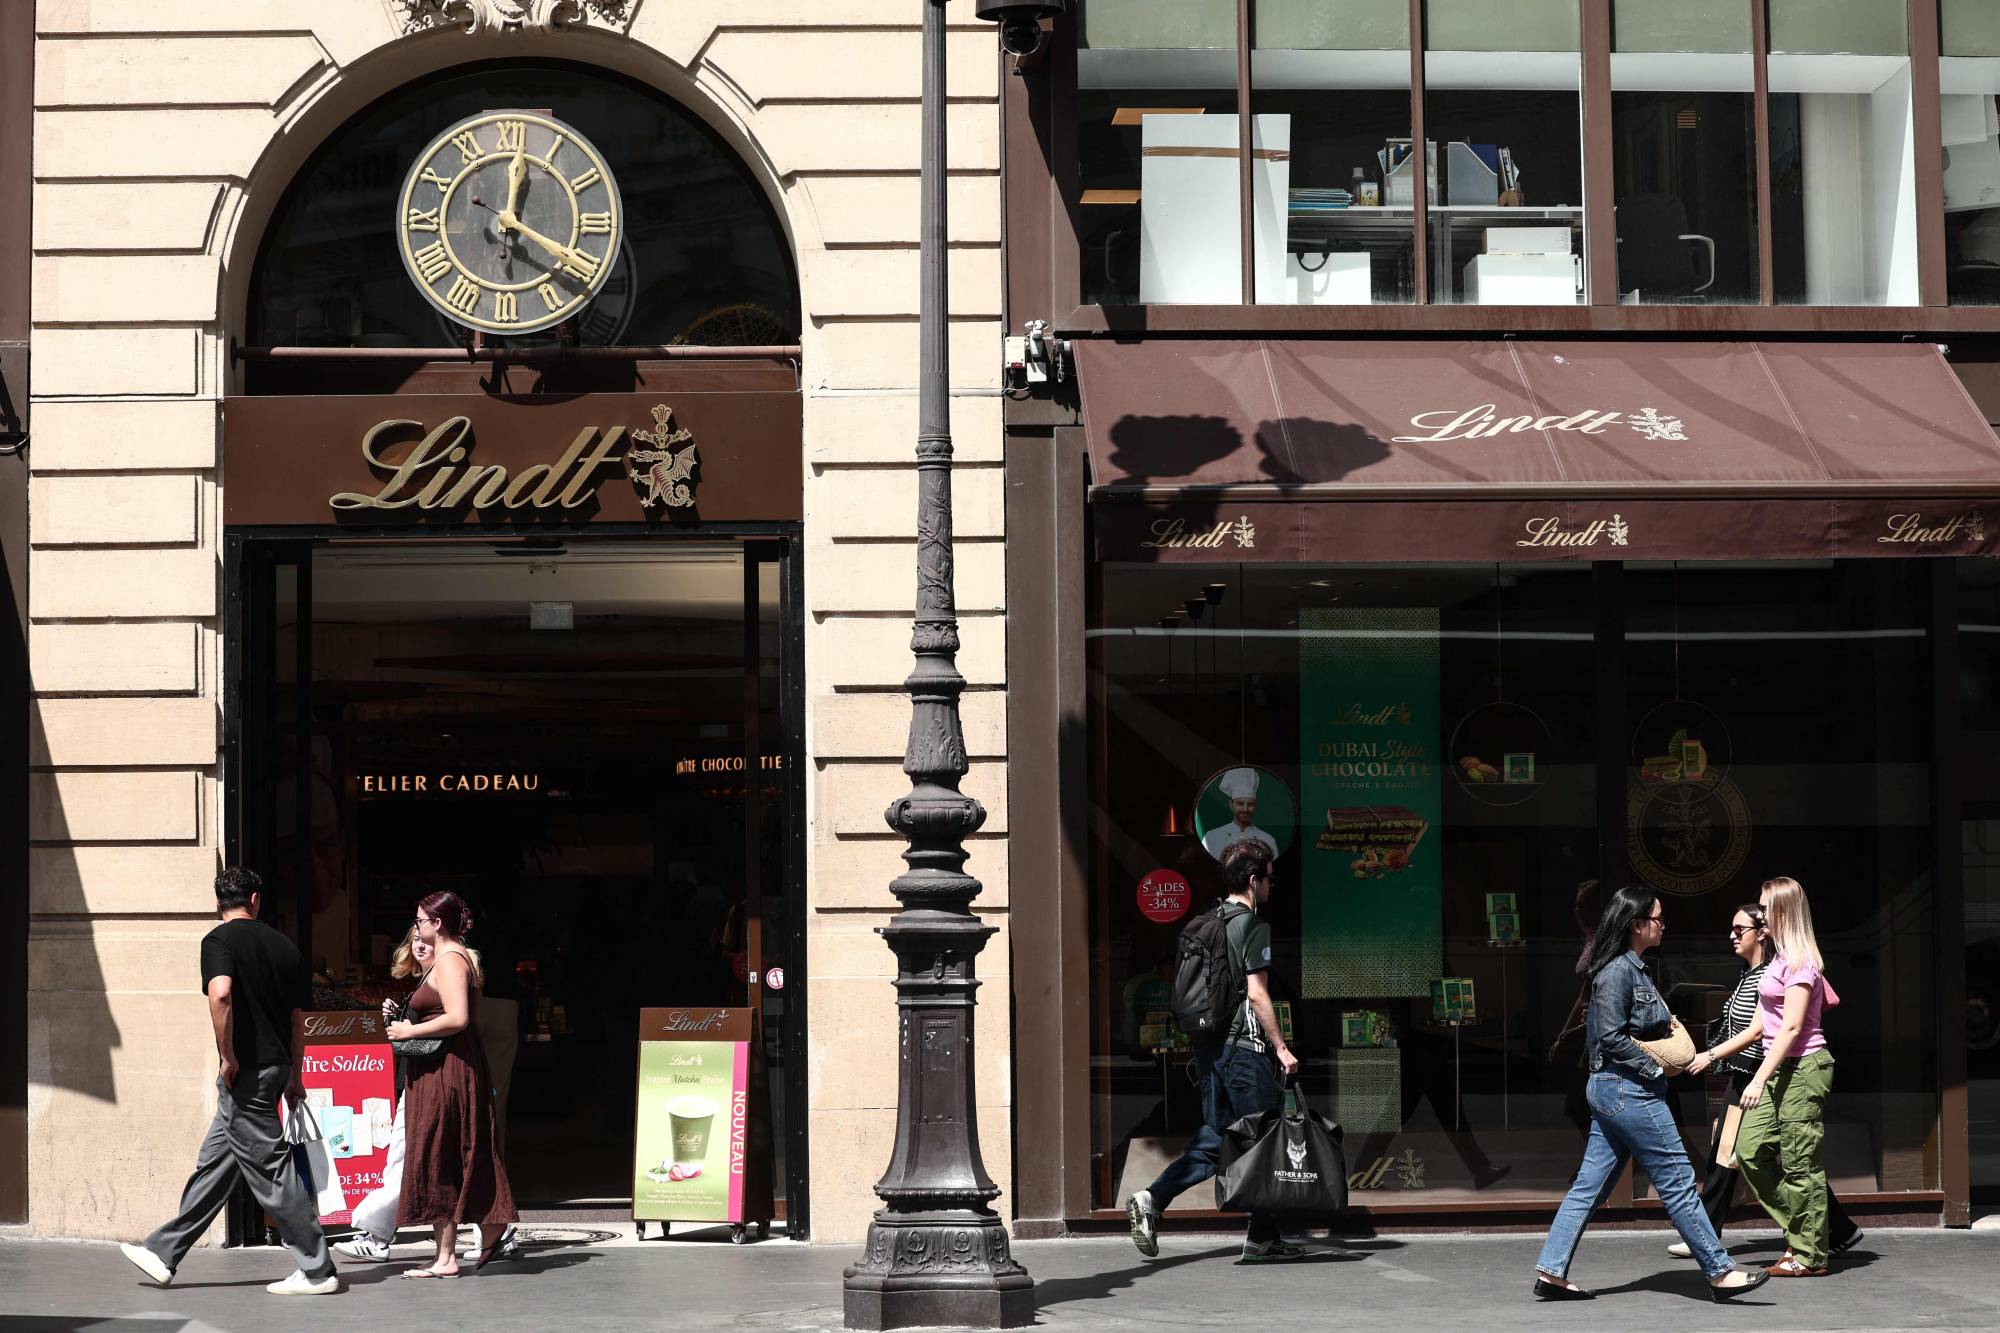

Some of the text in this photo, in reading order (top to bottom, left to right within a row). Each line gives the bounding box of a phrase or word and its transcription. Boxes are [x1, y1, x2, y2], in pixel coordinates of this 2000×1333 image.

[1391, 403, 1624, 443] Lindt
[328, 415, 626, 511] Lindt
[1141, 518, 1235, 549] Lindt
[1516, 516, 1607, 547] Lindt
[1877, 513, 1966, 544] Lindt
[1328, 703, 1397, 727] Lindt
[1320, 742, 1377, 758] DUBAI
[1312, 761, 1433, 777] CHOCOLATE
[440, 774, 538, 792] CADEAU
[1142, 882, 1185, 893] SLDES
[1148, 896, 1180, 909] -34%
[304, 1015, 357, 1037] Lindt
[663, 1011, 718, 1032] Lindt
[332, 1053, 385, 1073] Soldes
[731, 1090, 746, 1175] NOUVEAU
[1274, 1170, 1296, 1178] FATHER
